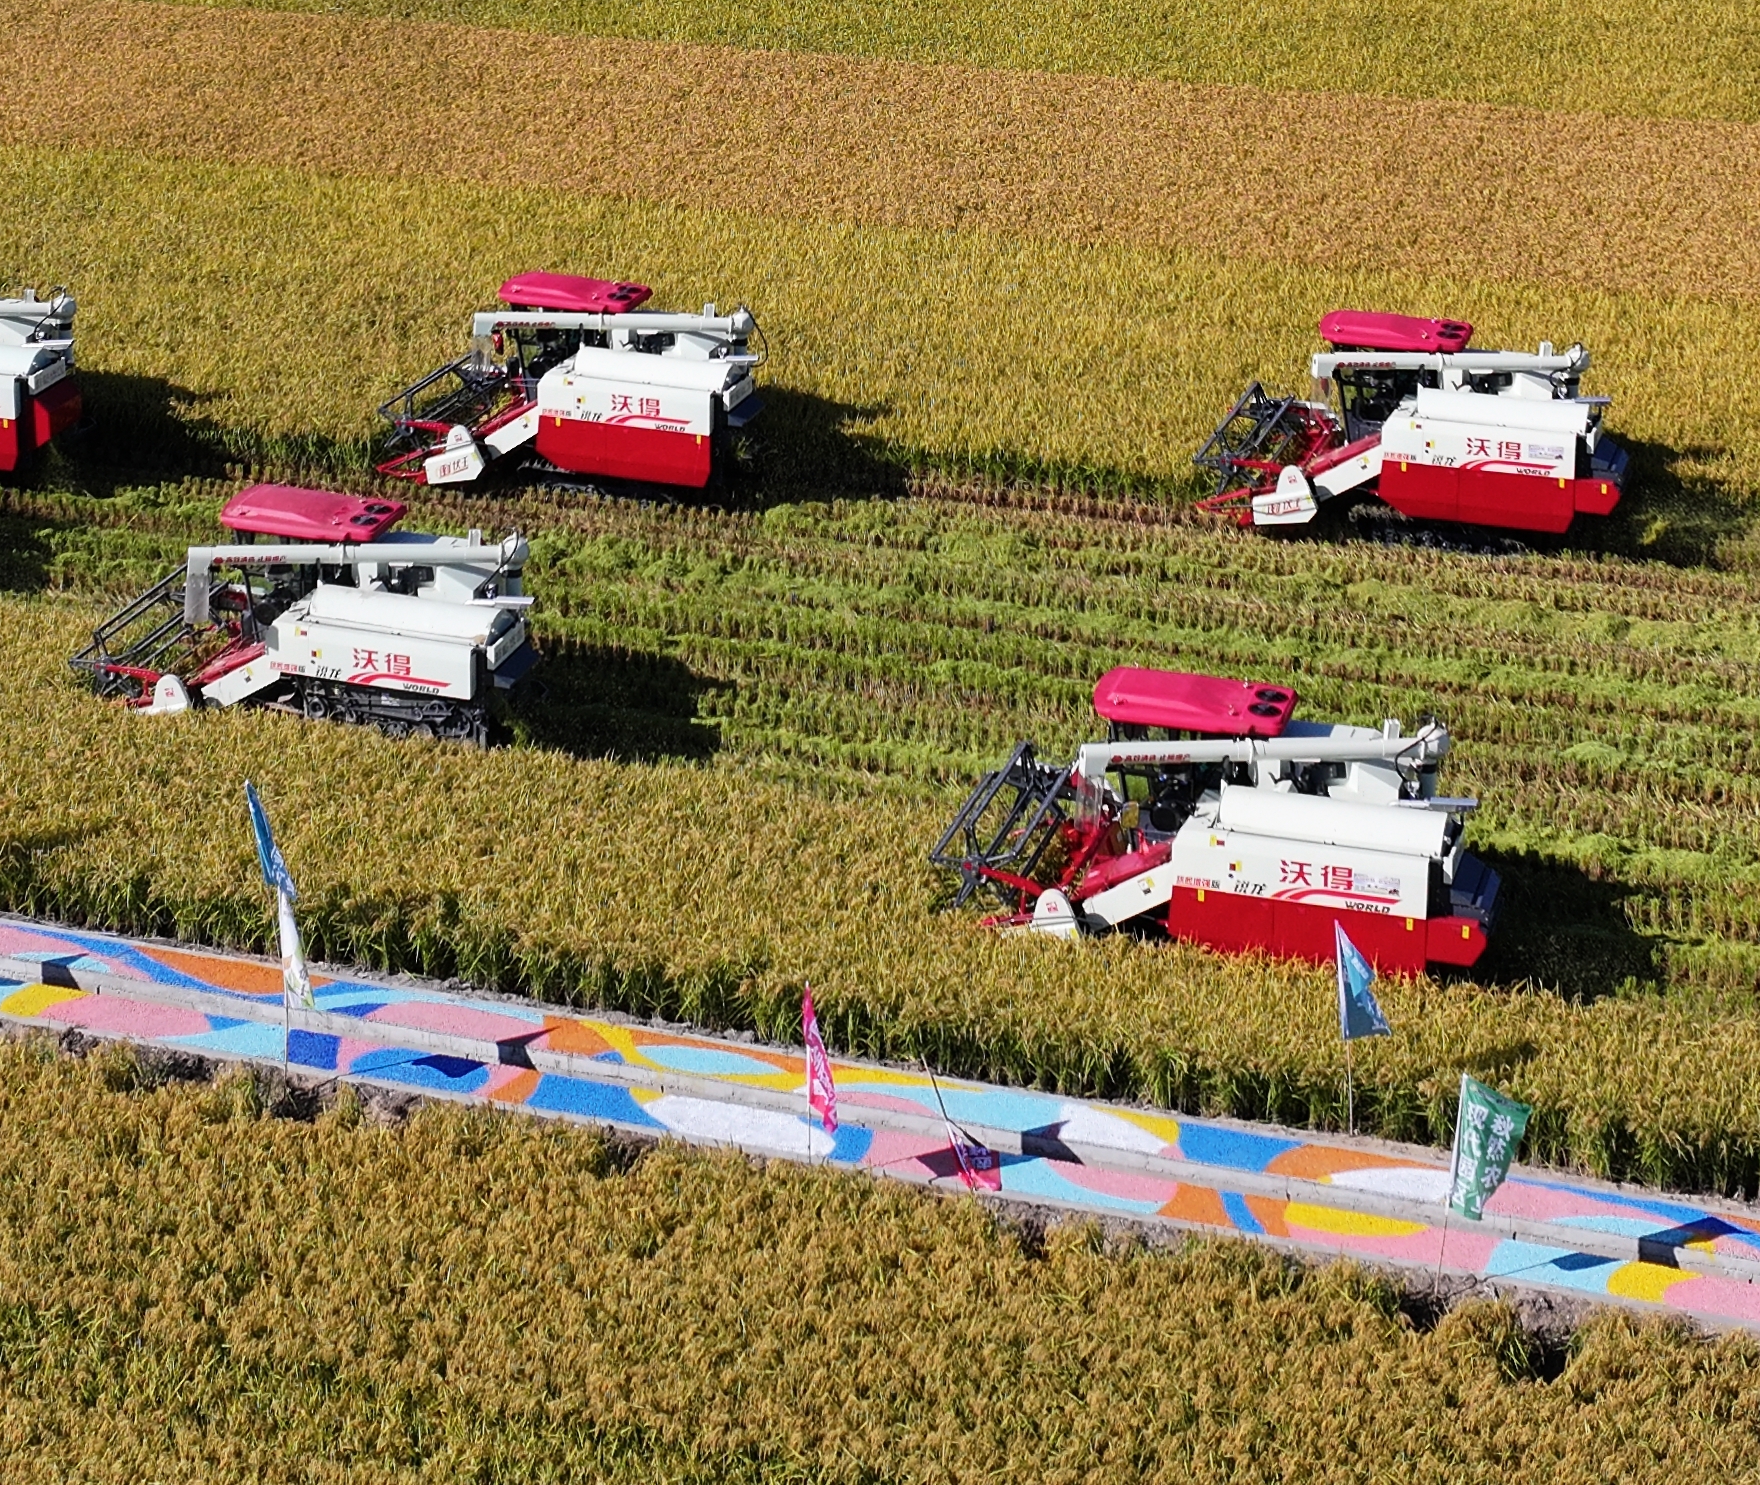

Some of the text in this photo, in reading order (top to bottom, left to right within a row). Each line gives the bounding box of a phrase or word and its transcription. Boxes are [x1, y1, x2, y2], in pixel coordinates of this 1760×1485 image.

[610, 393, 661, 417] 沃得
[654, 422, 686, 432] WORLD
[1465, 436, 1522, 460] 沃得
[1516, 467, 1551, 476] WORLD
[352, 647, 412, 676] 沃得
[402, 682, 441, 694] WORLD
[1279, 858, 1354, 891] 沃得
[1344, 899, 1391, 914] WORLD
